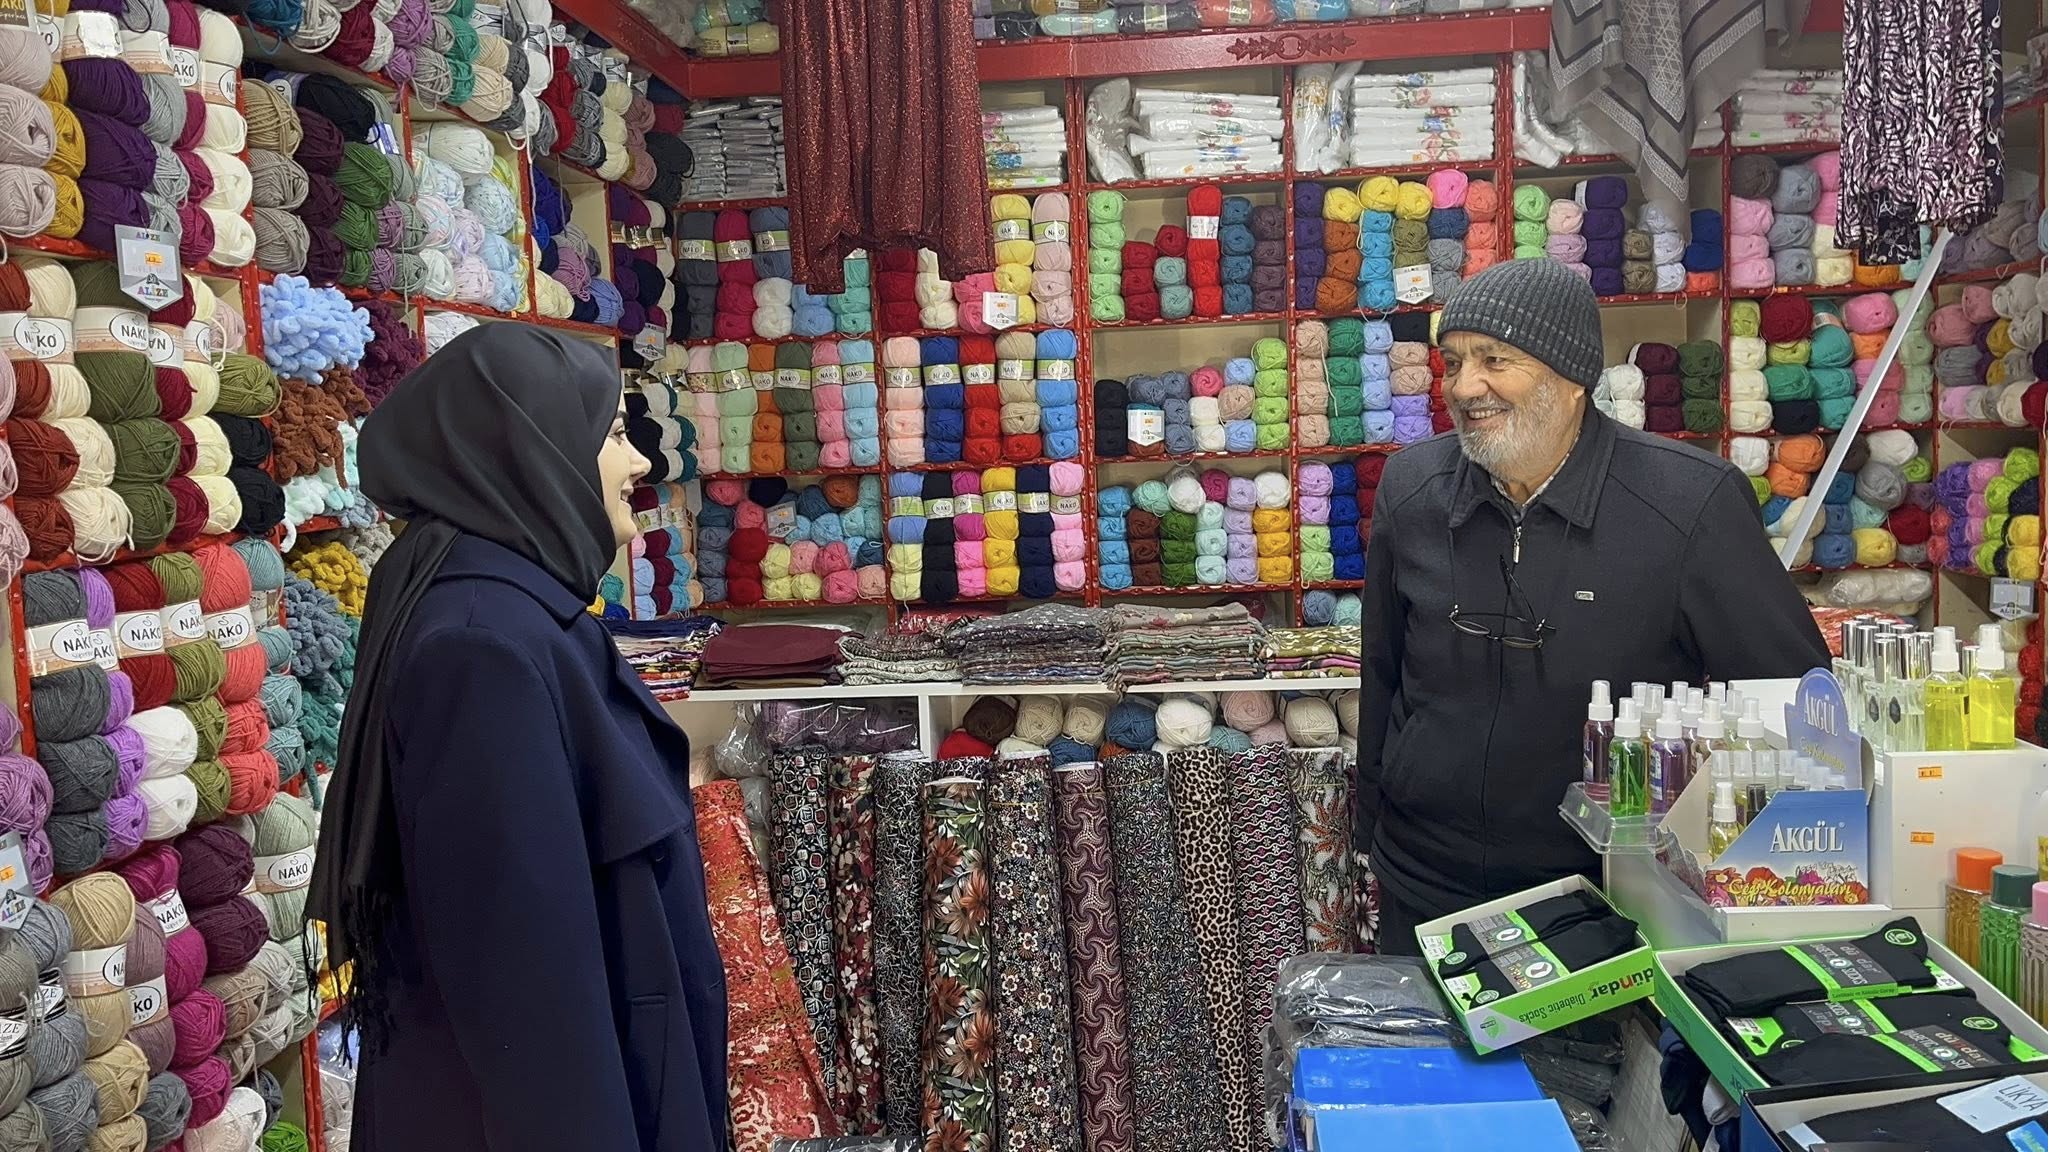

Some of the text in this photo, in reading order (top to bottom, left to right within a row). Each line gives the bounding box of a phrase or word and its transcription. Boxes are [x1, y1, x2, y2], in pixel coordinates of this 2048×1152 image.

[173, 63, 195, 78] AKO
[148, 338, 166, 351] NA
[180, 615, 203, 631] NAK
[207, 623, 243, 640] NAKO
[1803, 688, 1838, 737] AKGÜL
[1769, 820, 1845, 853] AKGÜL
[278, 862, 308, 881] NAKO
[156, 903, 184, 925] NAKO
[1518, 967, 1654, 1024] dündar Diabetic Socks
[133, 997, 153, 1013] KO
